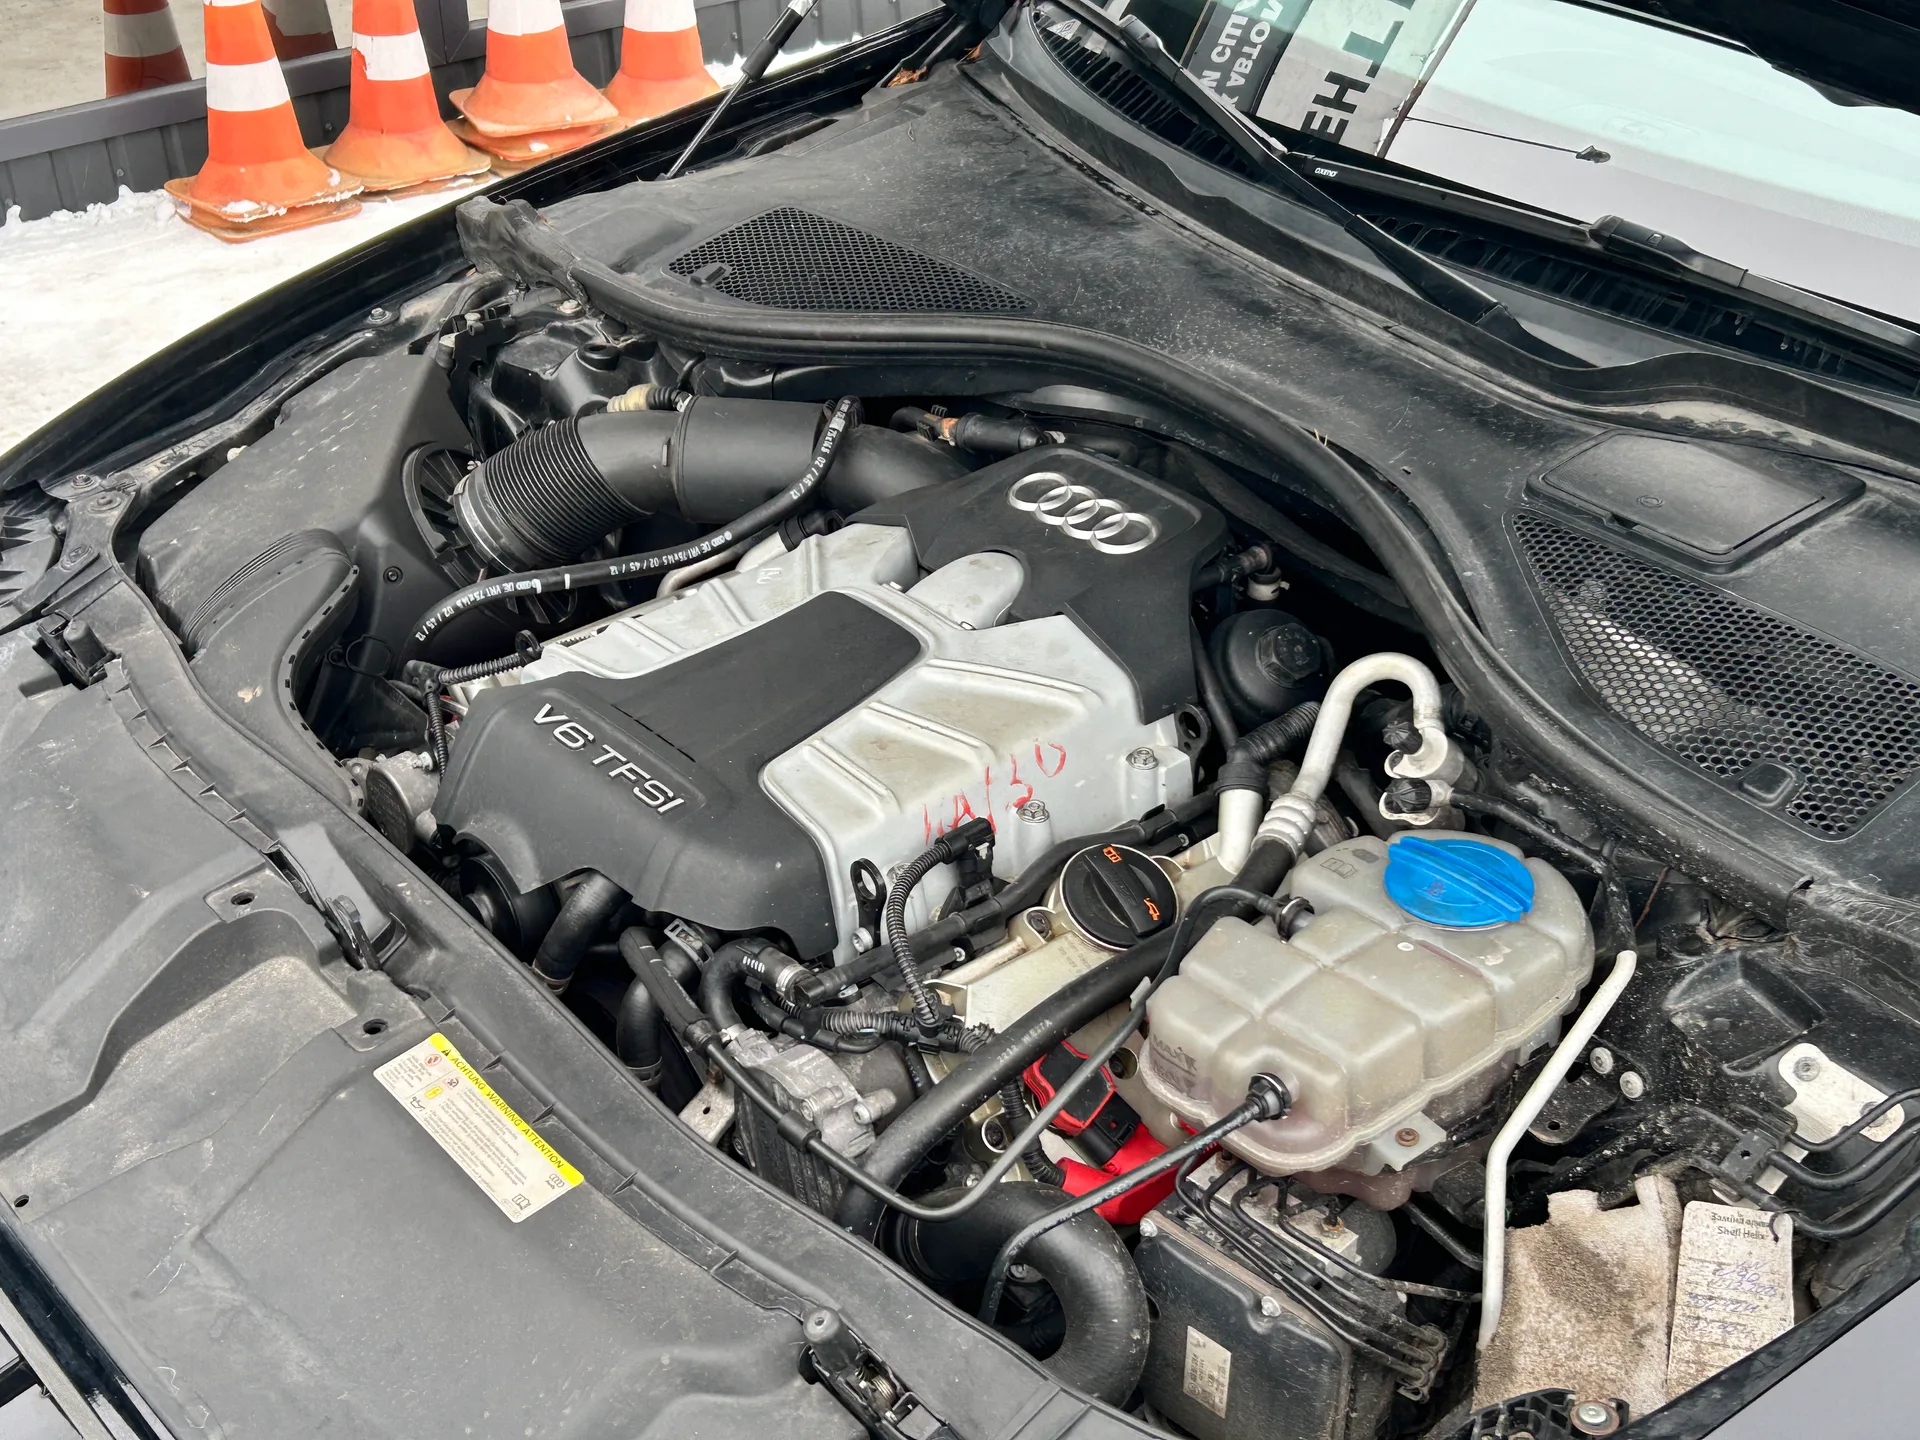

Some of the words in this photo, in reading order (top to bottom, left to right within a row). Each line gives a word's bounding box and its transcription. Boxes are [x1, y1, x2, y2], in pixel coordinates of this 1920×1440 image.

[533, 703, 596, 750] V6
[592, 744, 686, 815] TFSI
[452, 1057, 487, 1091] ACHTUNG
[486, 1089, 524, 1127] WARNING
[522, 1127, 565, 1169] ATTENTION
[1717, 1225, 1741, 1238] Shell
[1743, 1228, 1765, 1240] Helix
